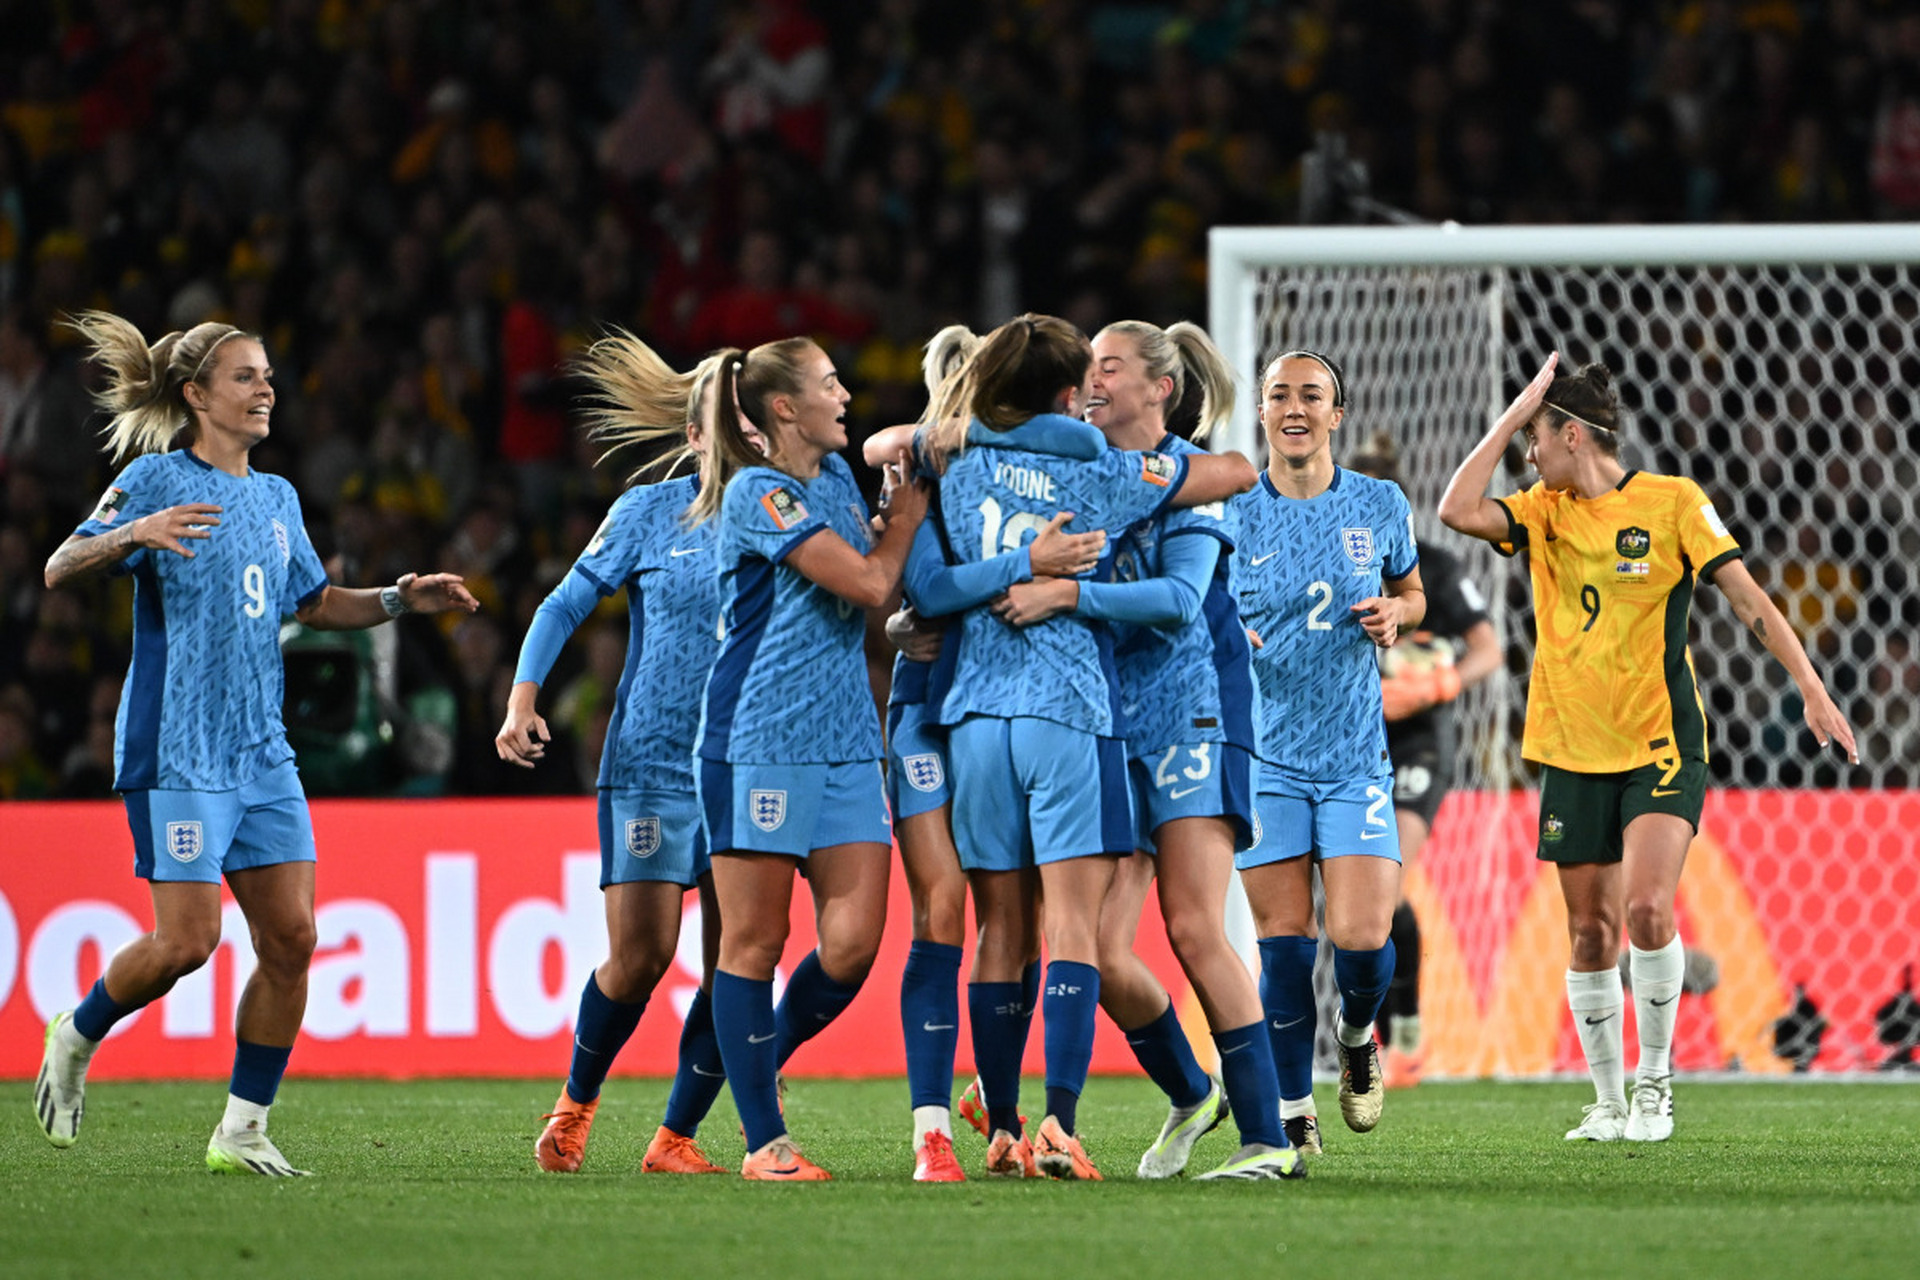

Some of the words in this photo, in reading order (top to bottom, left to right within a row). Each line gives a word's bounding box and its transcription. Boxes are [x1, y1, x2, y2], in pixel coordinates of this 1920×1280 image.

[994, 462, 1056, 502] TOONE
[244, 564, 265, 619] 9
[1306, 580, 1333, 630] 2
[1581, 584, 1600, 632] 9
[1156, 742, 1211, 789] 23
[1656, 757, 1681, 786] 9
[1365, 785, 1388, 829] 2
